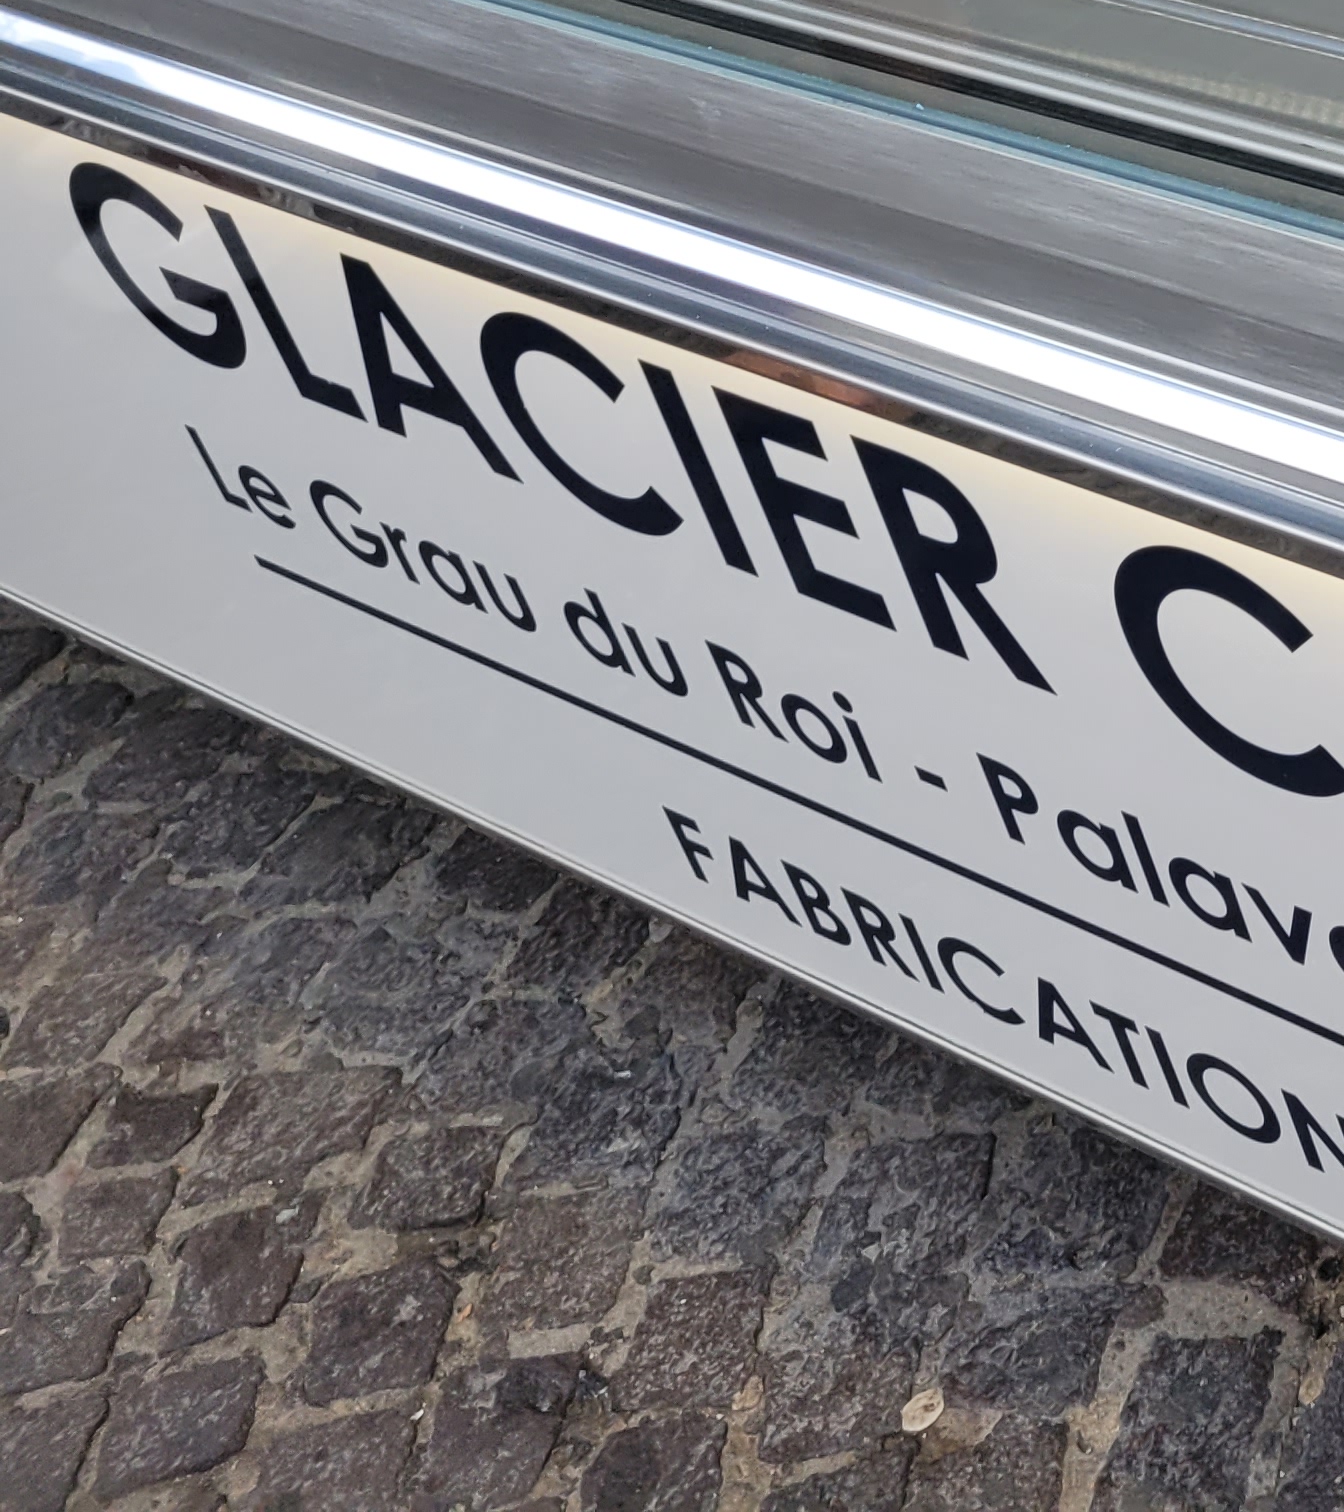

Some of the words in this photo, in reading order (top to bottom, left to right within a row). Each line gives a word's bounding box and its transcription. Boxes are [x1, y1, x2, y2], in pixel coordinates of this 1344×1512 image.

[68, 161, 1058, 696] GLACIER
[184, 424, 297, 530] Le
[309, 479, 537, 632] Grau
[563, 588, 689, 697] du
[704, 639, 883, 784] Roi
